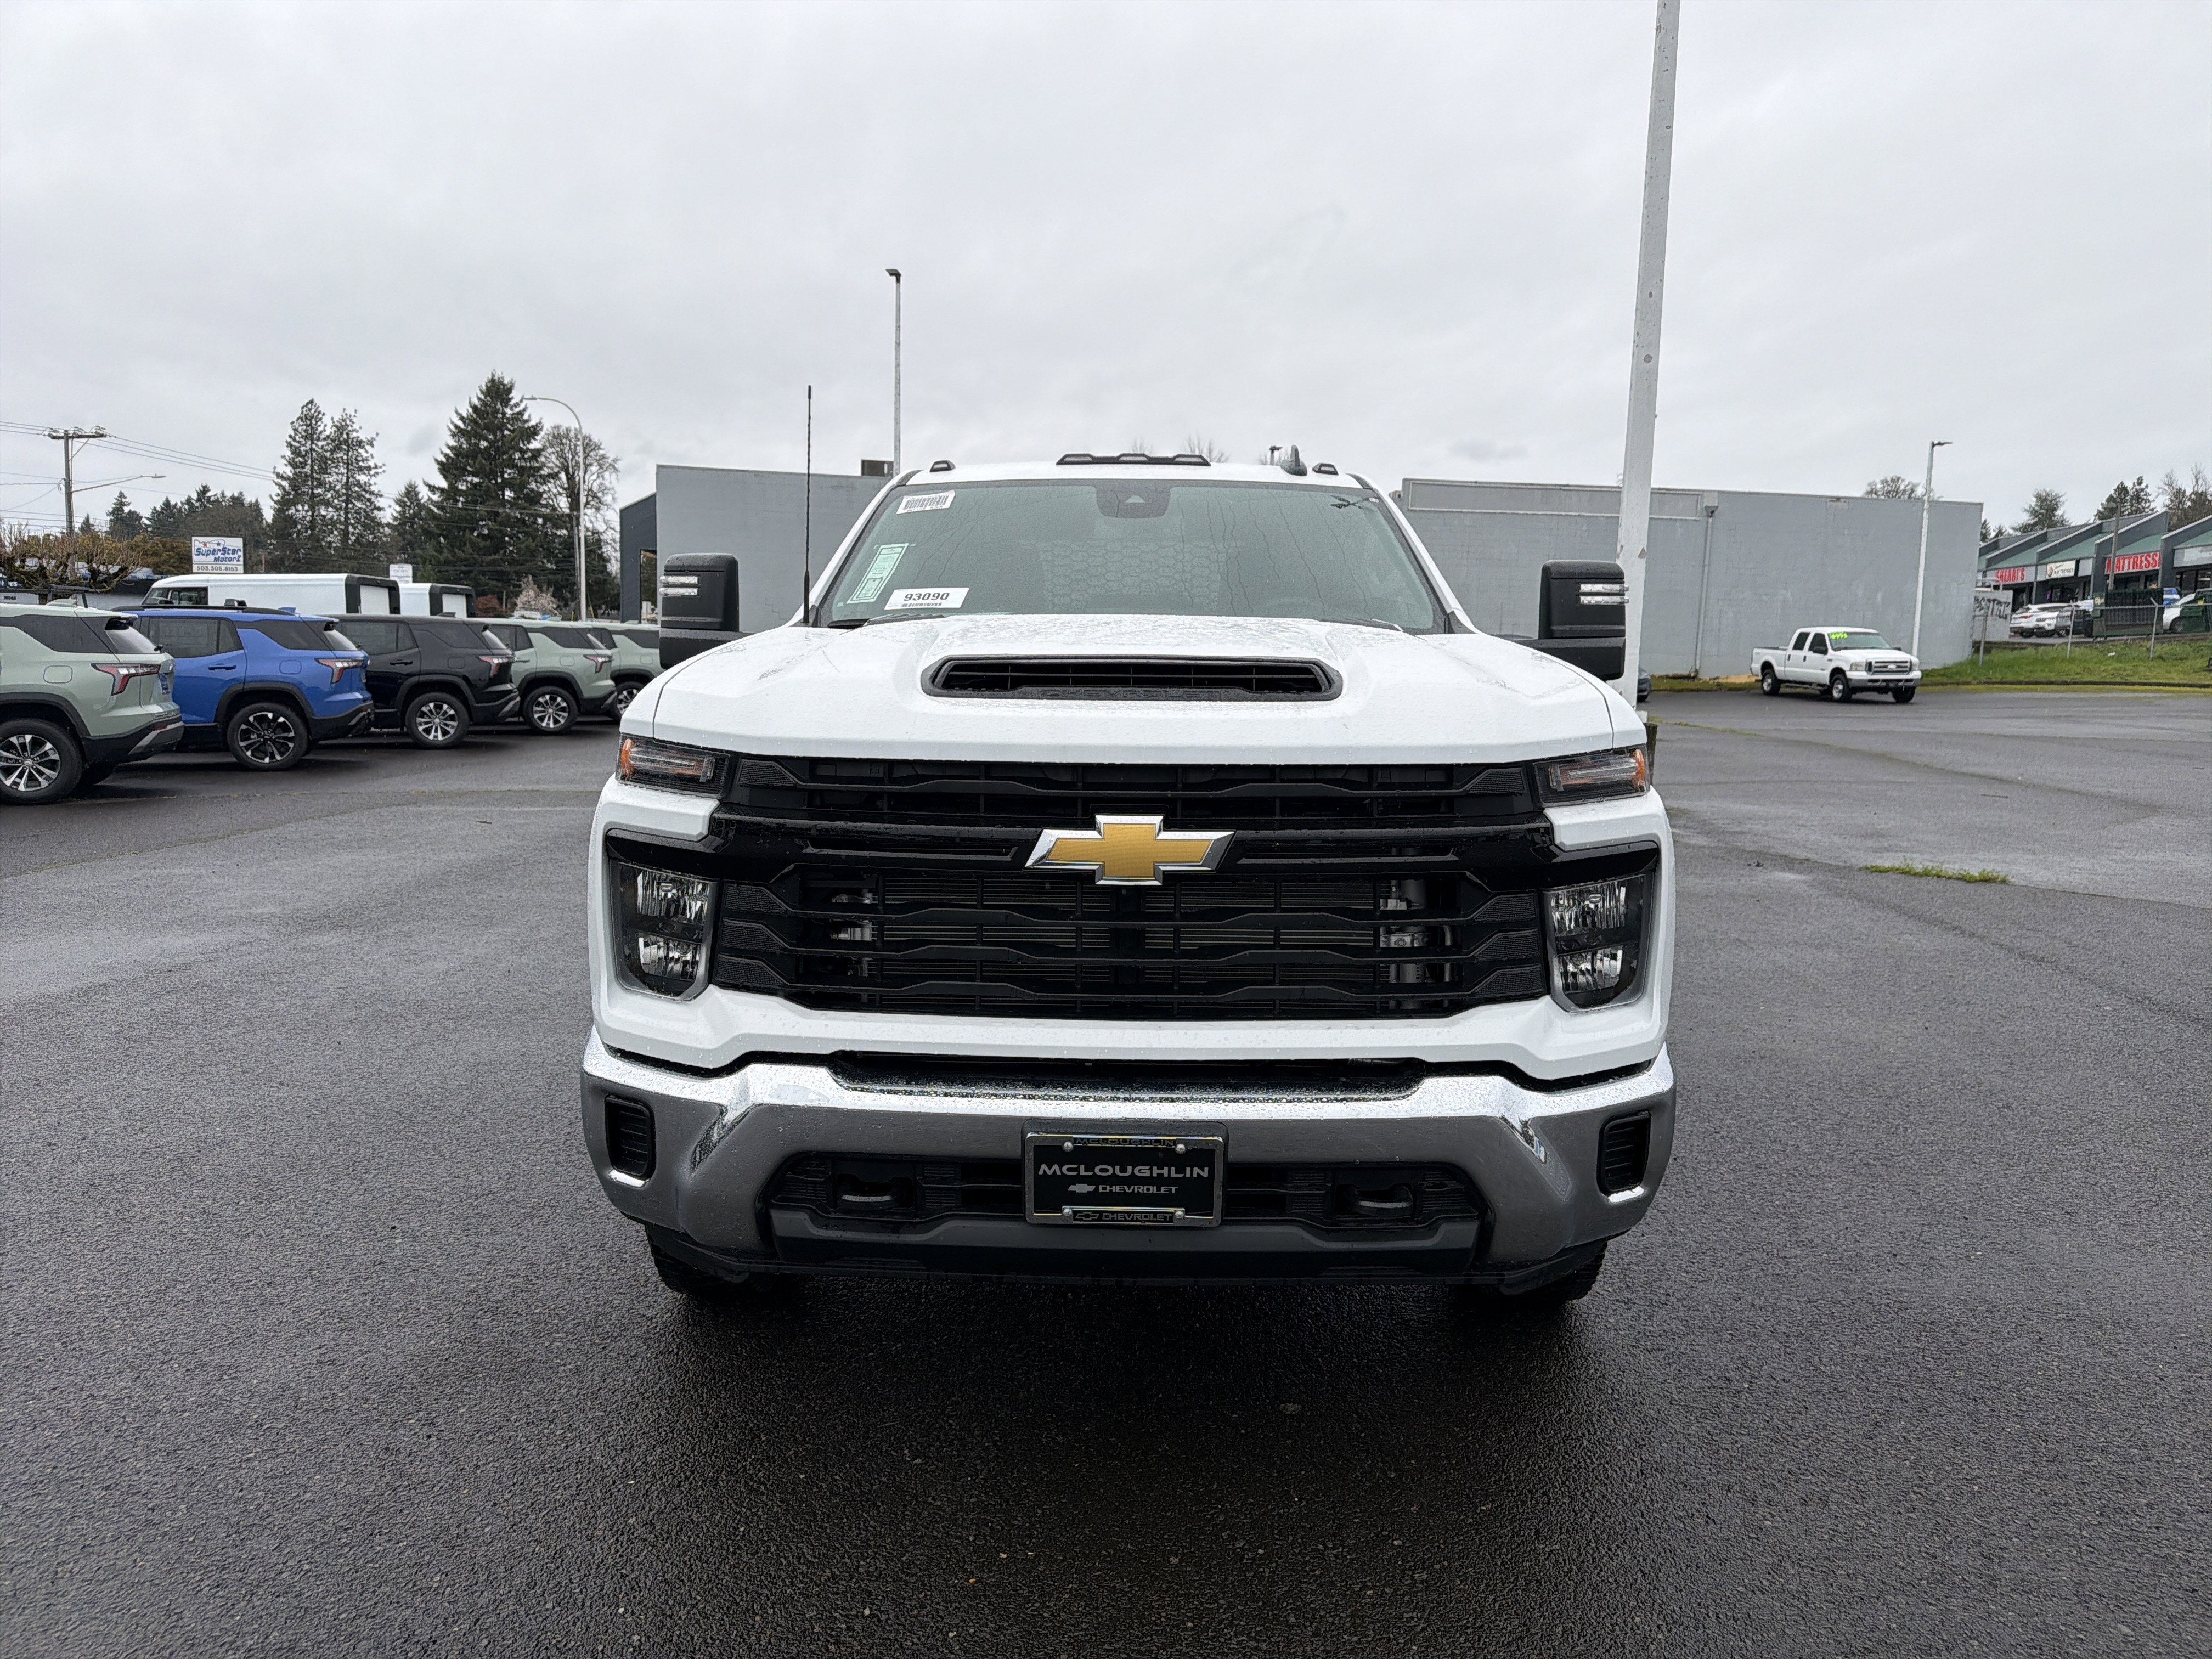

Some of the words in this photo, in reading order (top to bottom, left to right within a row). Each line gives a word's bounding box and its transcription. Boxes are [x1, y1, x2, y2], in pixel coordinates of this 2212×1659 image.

[195, 547, 241, 557] SuperStar
[904, 592, 950, 601] 93090
[1075, 1138, 1175, 1147] MCLOUGHLIN
[1038, 1164, 1209, 1178] MCLOUGHLIN
[1098, 1184, 1178, 1194] CHEVROLET
[1102, 1212, 1172, 1221] CHEVROLET
